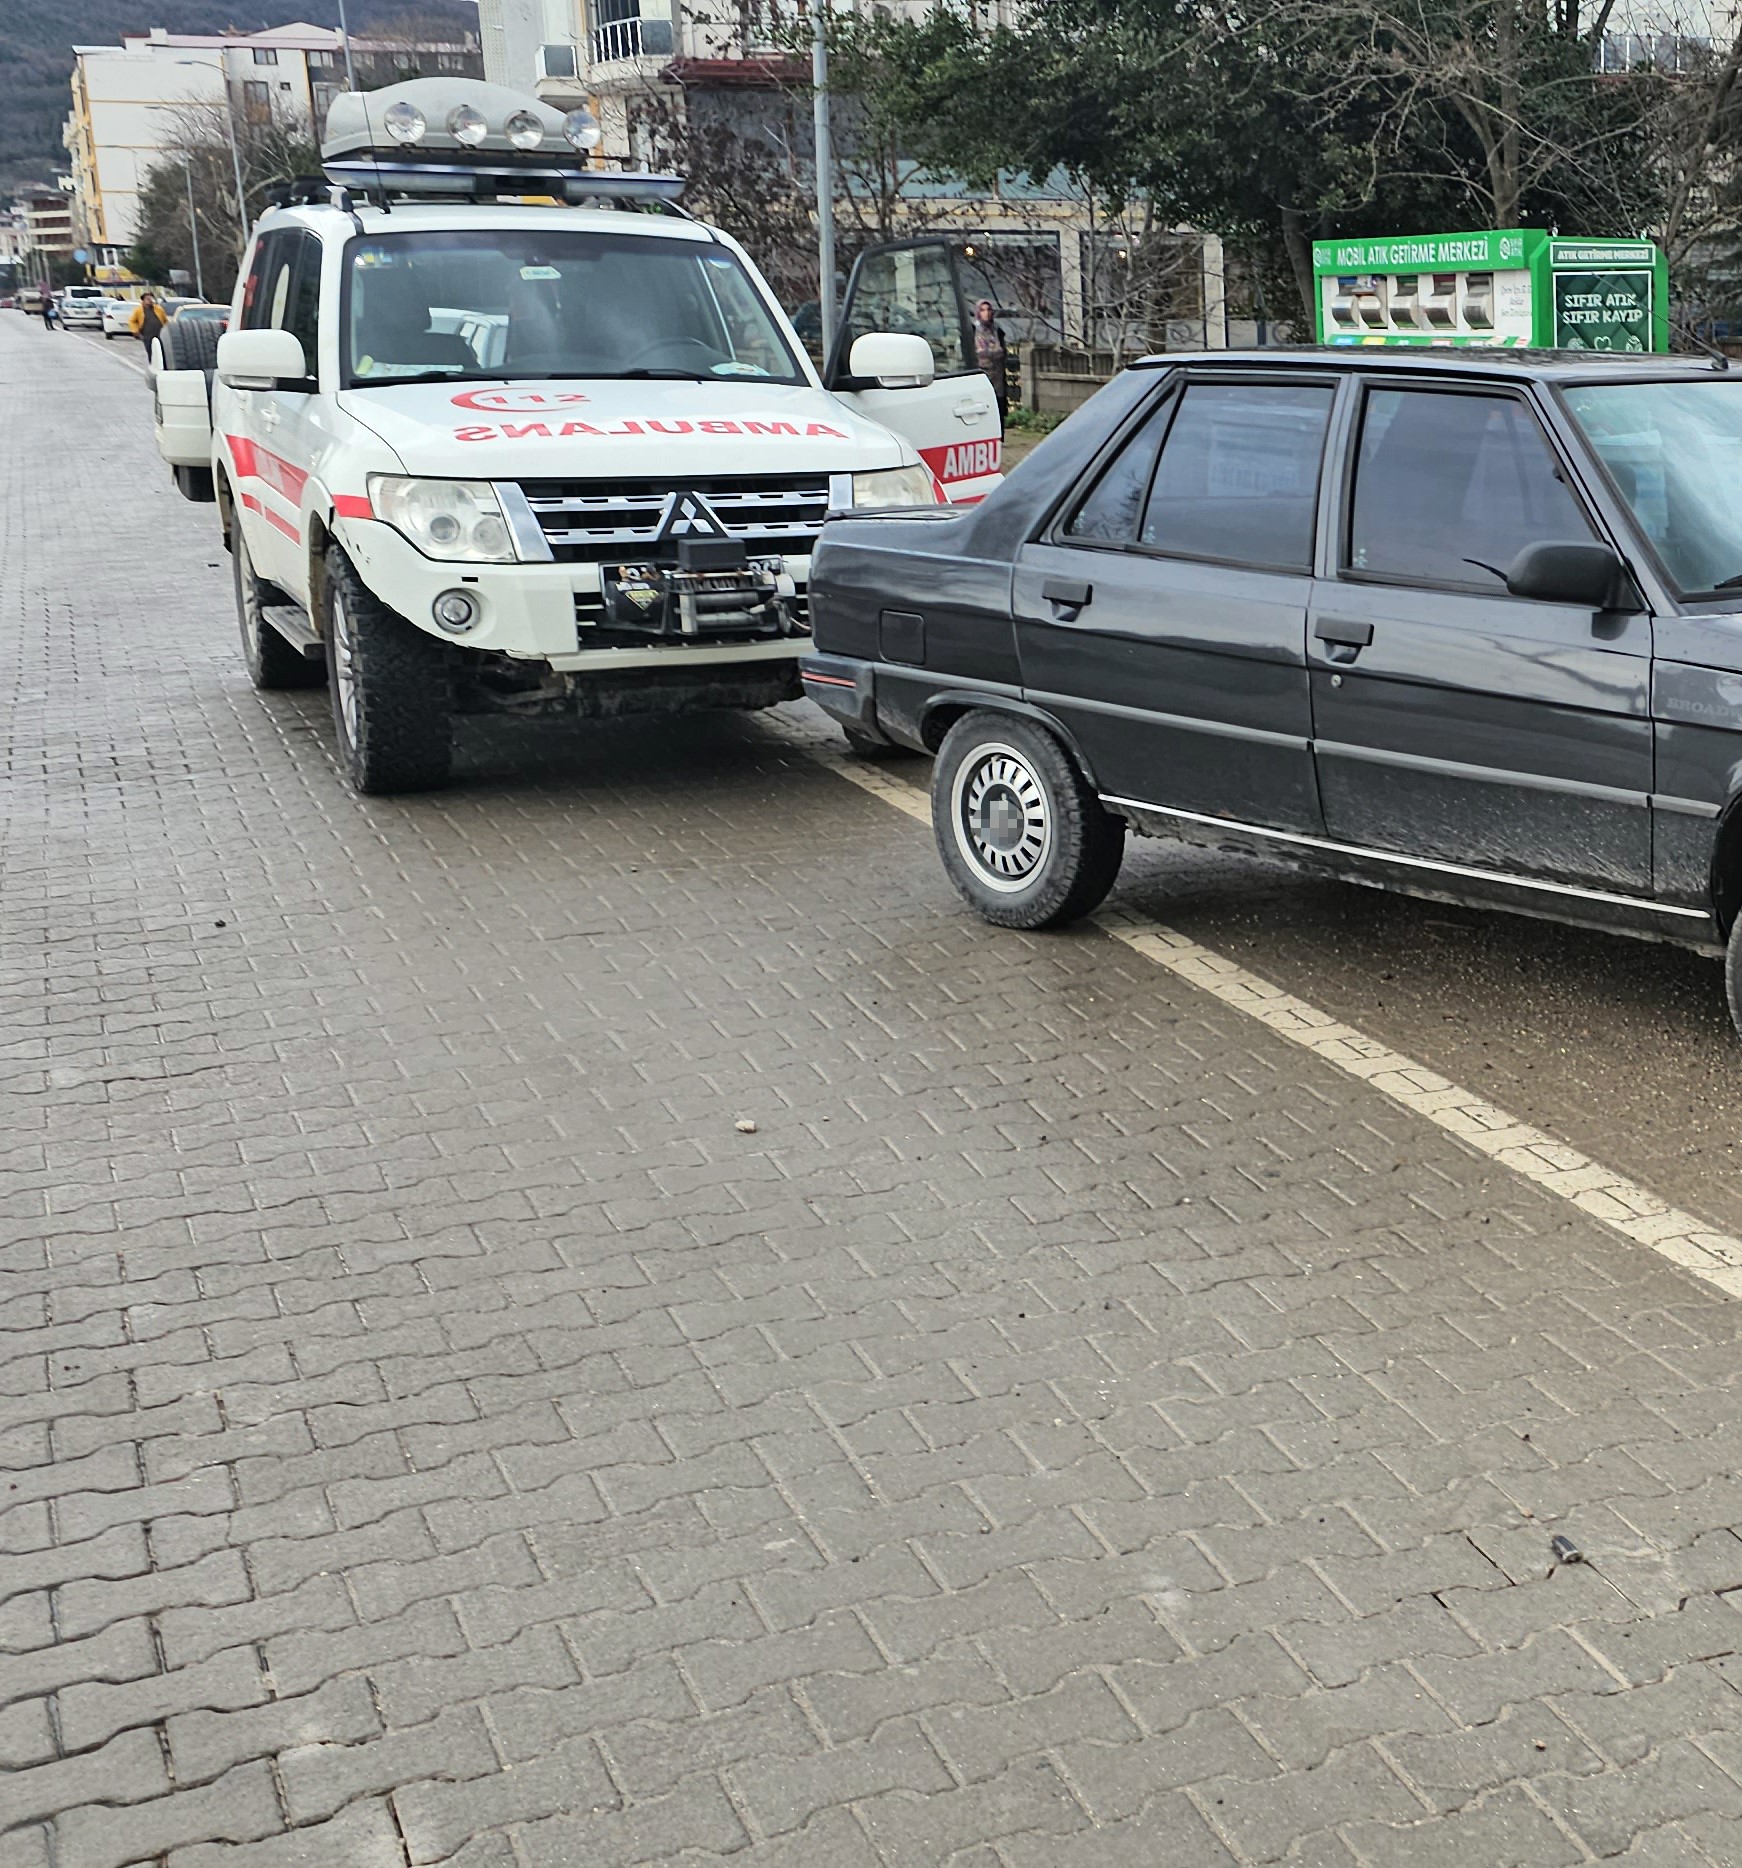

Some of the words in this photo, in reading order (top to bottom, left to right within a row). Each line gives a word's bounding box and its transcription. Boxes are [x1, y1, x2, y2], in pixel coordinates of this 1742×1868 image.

[1368, 245, 1389, 265] ATIK
[1391, 240, 1435, 264] GETİRME
[1438, 236, 1489, 262] MERKEZİ
[1564, 294, 1602, 308] SIFIR
[1605, 293, 1637, 307] ATIK
[1562, 310, 1600, 324] SIFIR
[1602, 309, 1643, 323] KAYIP
[481, 394, 592, 404] 112
